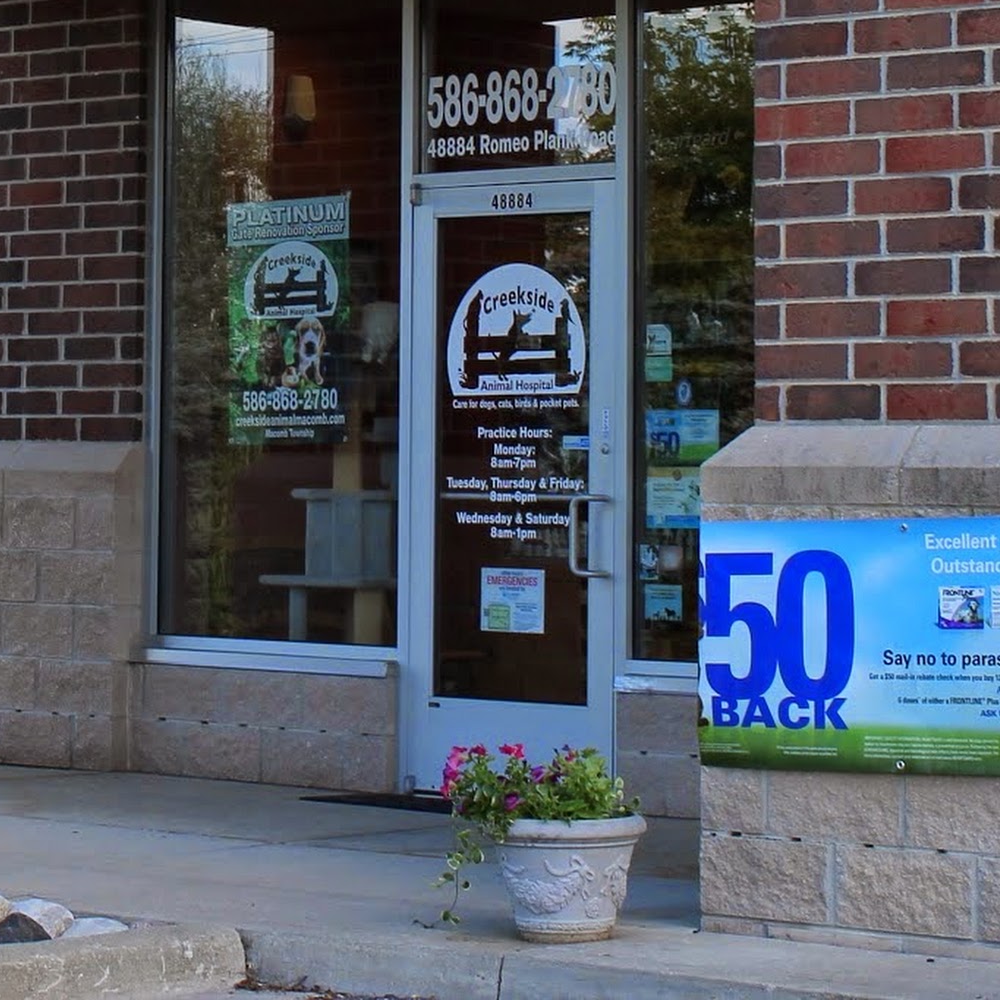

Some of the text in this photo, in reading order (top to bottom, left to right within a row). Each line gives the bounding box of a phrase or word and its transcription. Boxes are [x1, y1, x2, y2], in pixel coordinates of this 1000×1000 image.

[427, 61, 616, 129] 586-868-2780
[427, 136, 476, 158] 48884
[479, 133, 530, 155] Romeo
[491, 192, 533, 210] 48884
[232, 201, 346, 227] PLATINUM
[254, 225, 305, 239] Renovation
[306, 223, 345, 237] Sponsor
[268, 251, 317, 271] Creekside
[483, 285, 555, 315] Creekside
[480, 379, 554, 393] Animal Hospital
[242, 388, 338, 411] 586-868-2780
[477, 426, 553, 440] Practice Hours:
[493, 443, 536, 457] Monday:
[490, 457, 537, 470] 8am-7pm
[446, 476, 585, 491] Tuesday, Thursday & Friday:
[489, 491, 537, 505] 8am-6pm
[456, 511, 571, 526] Wednesday & Saturday
[490, 526, 537, 541] 8am-1pm
[924, 533, 998, 550] Excellent
[486, 575, 538, 587] EMERGENCIES
[699, 550, 854, 701] 50
[883, 649, 912, 669] Say
[916, 653, 937, 666] no
[941, 652, 957, 666] to
[711, 696, 849, 730] BACK
